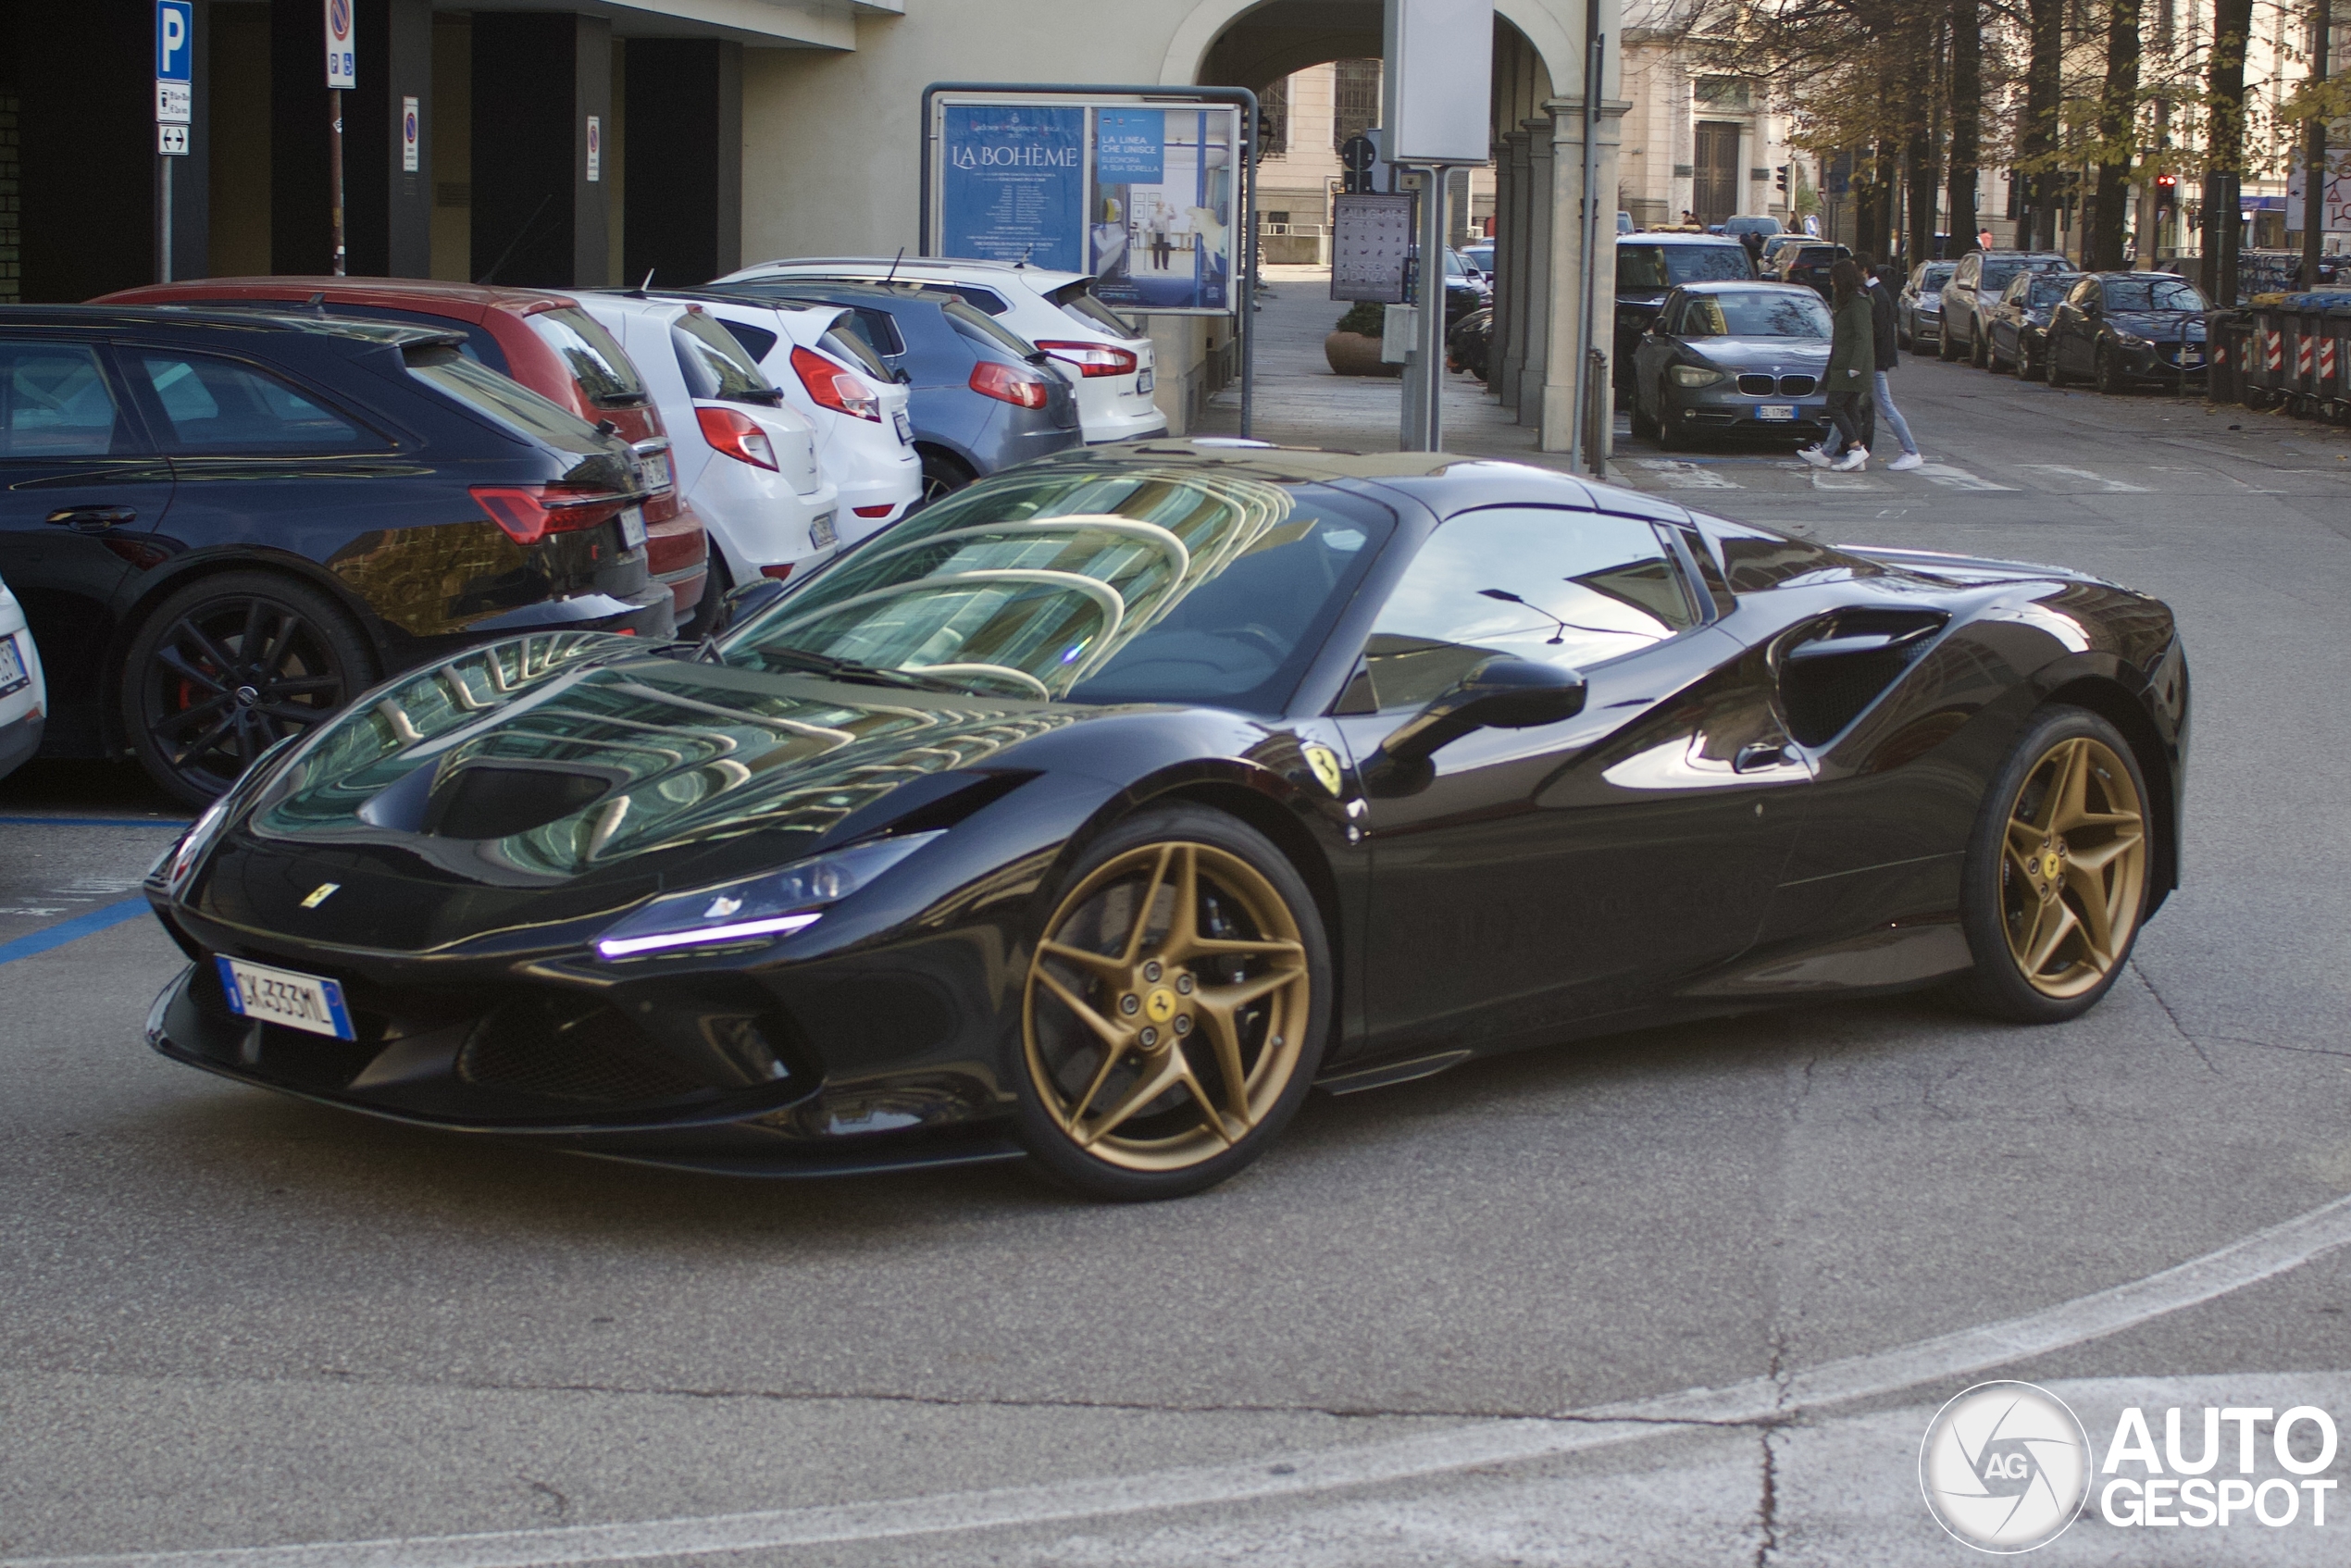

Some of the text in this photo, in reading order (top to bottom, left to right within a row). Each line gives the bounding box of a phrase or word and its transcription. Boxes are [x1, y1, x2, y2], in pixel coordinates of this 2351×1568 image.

[162, 7, 185, 72] P
[1101, 135, 1148, 144] LA LINEA
[1101, 144, 1157, 155] CHE UNISCE
[952, 143, 1077, 169] LA BOHÈME
[1101, 156, 1141, 164] ELEONORA
[1126, 165, 1160, 173] SORELLA
